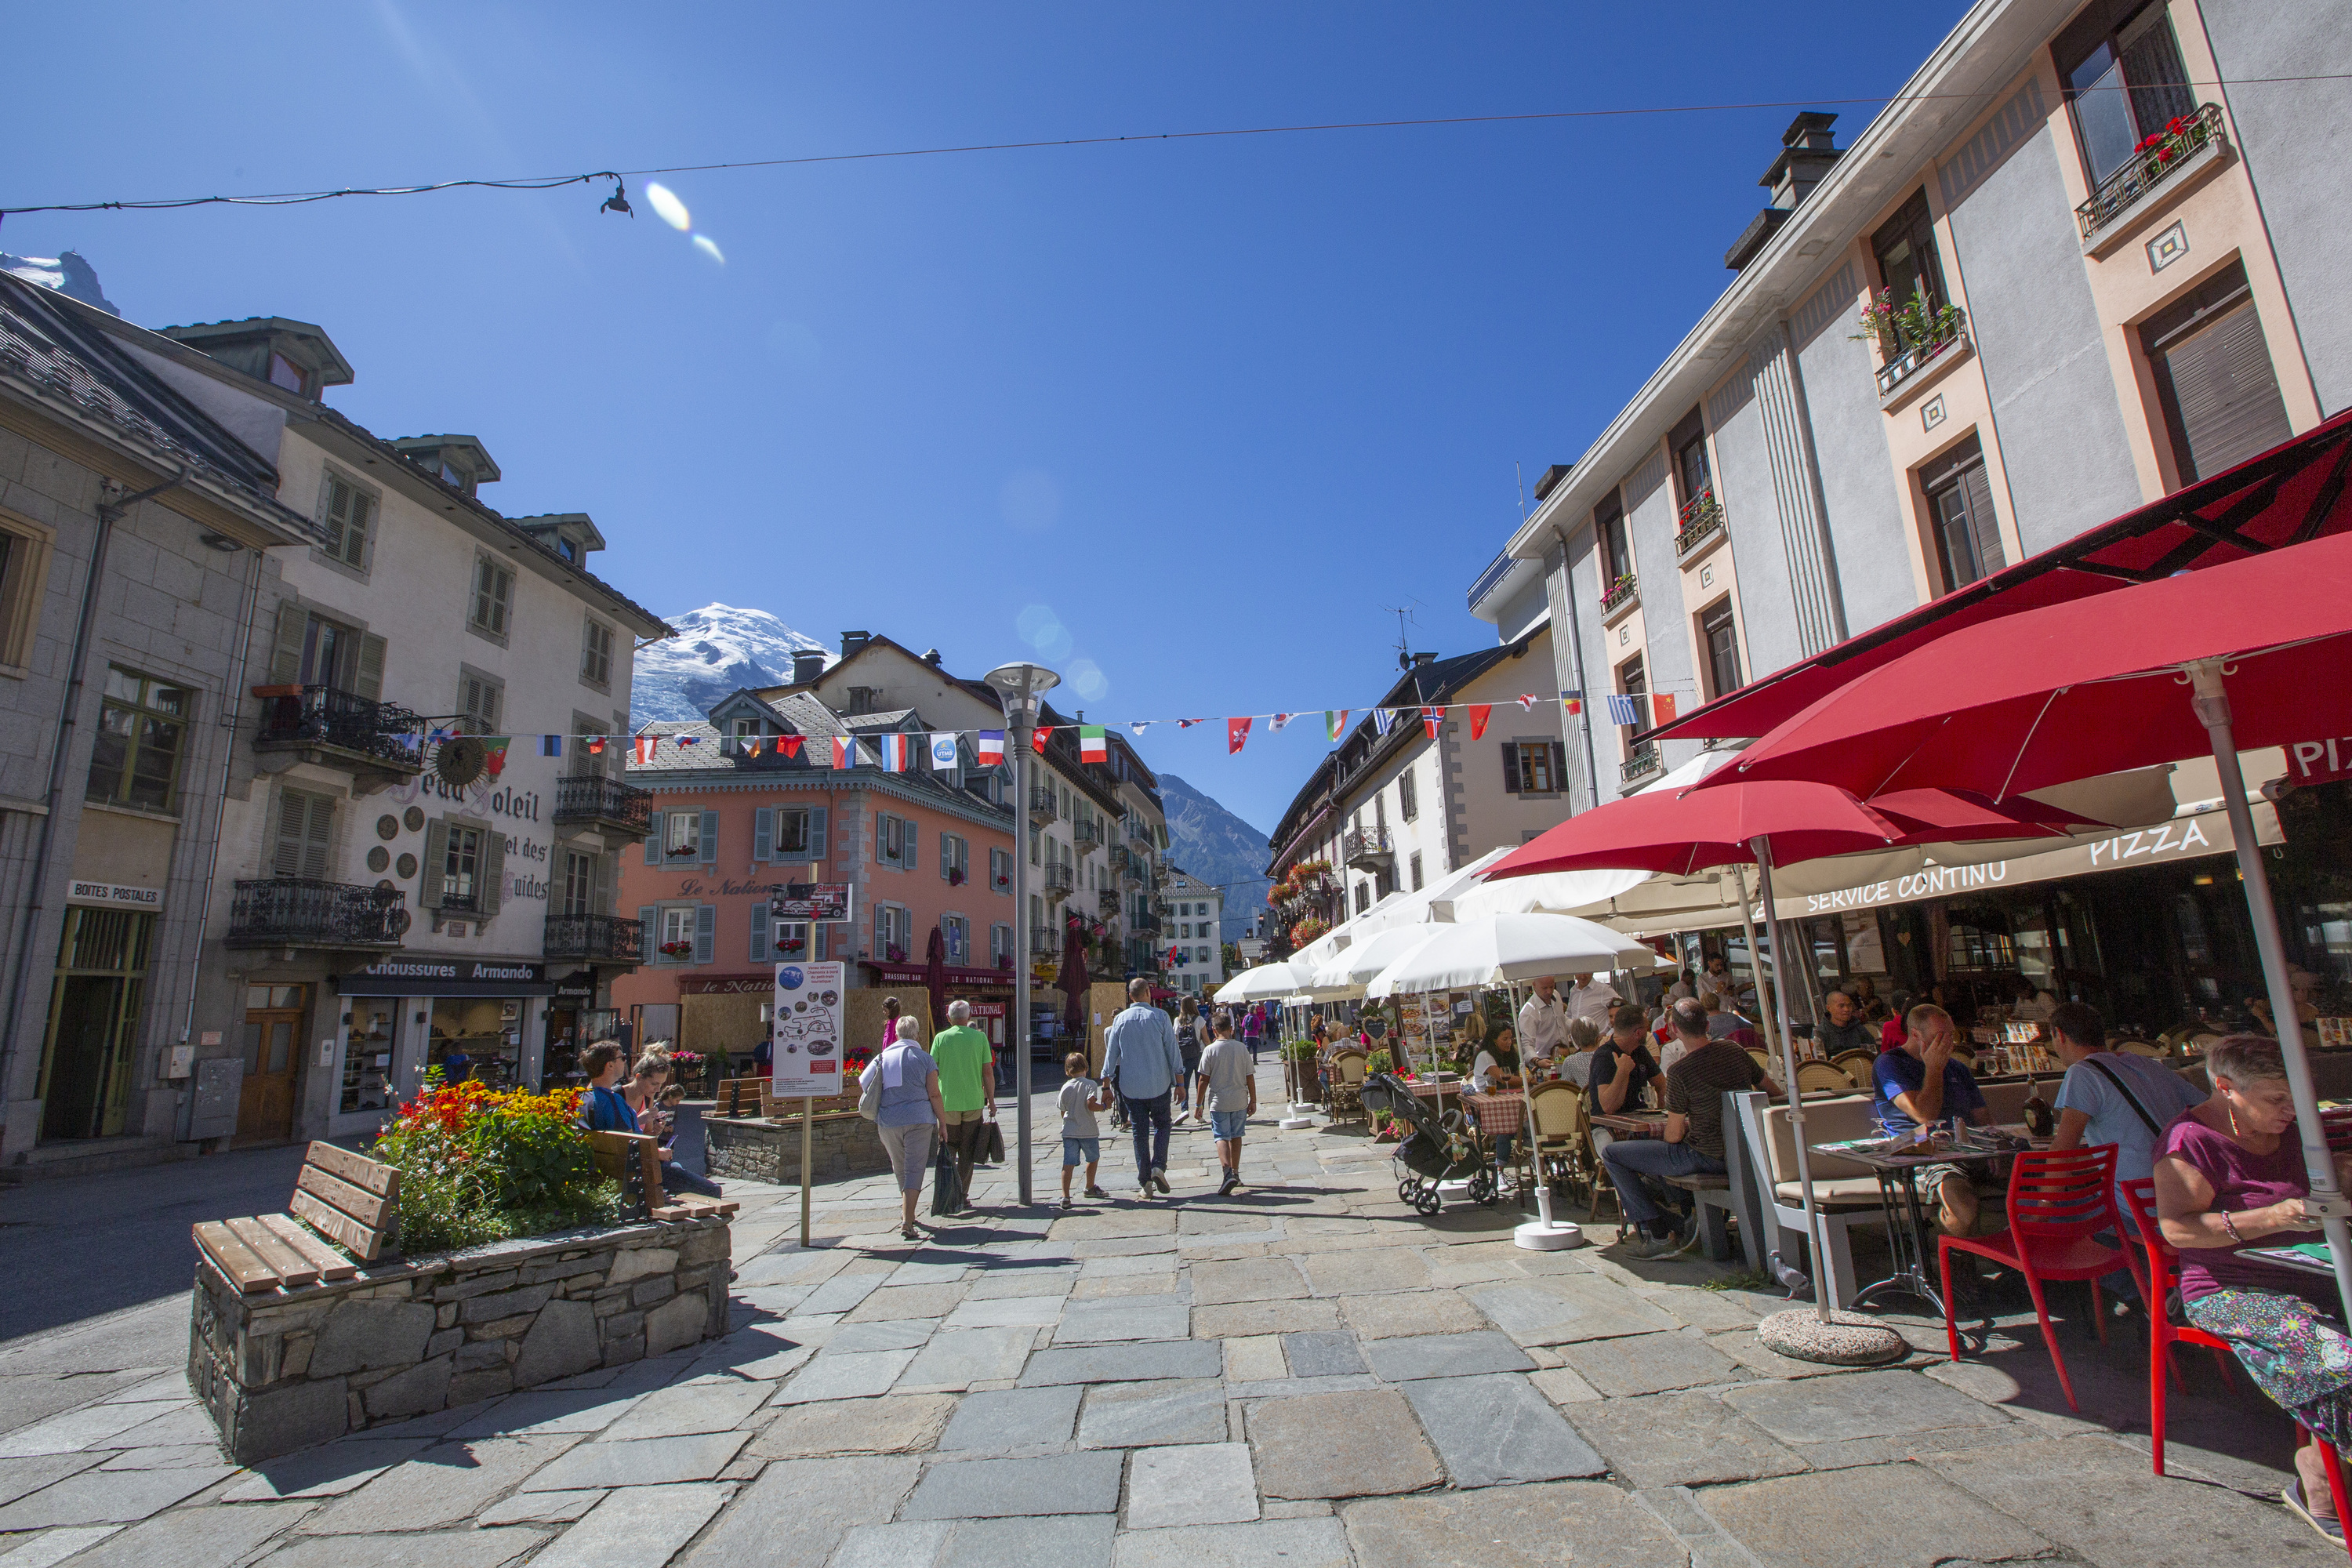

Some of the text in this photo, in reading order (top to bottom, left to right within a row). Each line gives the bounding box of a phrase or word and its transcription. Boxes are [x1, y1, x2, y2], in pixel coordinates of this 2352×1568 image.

[2293, 737, 2352, 778] PI
[506, 836, 548, 862] et des
[2090, 818, 2209, 866] PIZZA
[74, 884, 157, 902] BOITES POSTALES
[677, 879, 703, 897] Le
[817, 884, 846, 893] Station
[1807, 880, 1890, 913] SERVICE
[1897, 860, 2006, 898] CONTINU
[366, 963, 533, 979] Chaussures Armando
[558, 985, 591, 996] Armando
[702, 980, 775, 993] le Natio
[969, 1005, 1002, 1014] NATIONAL
